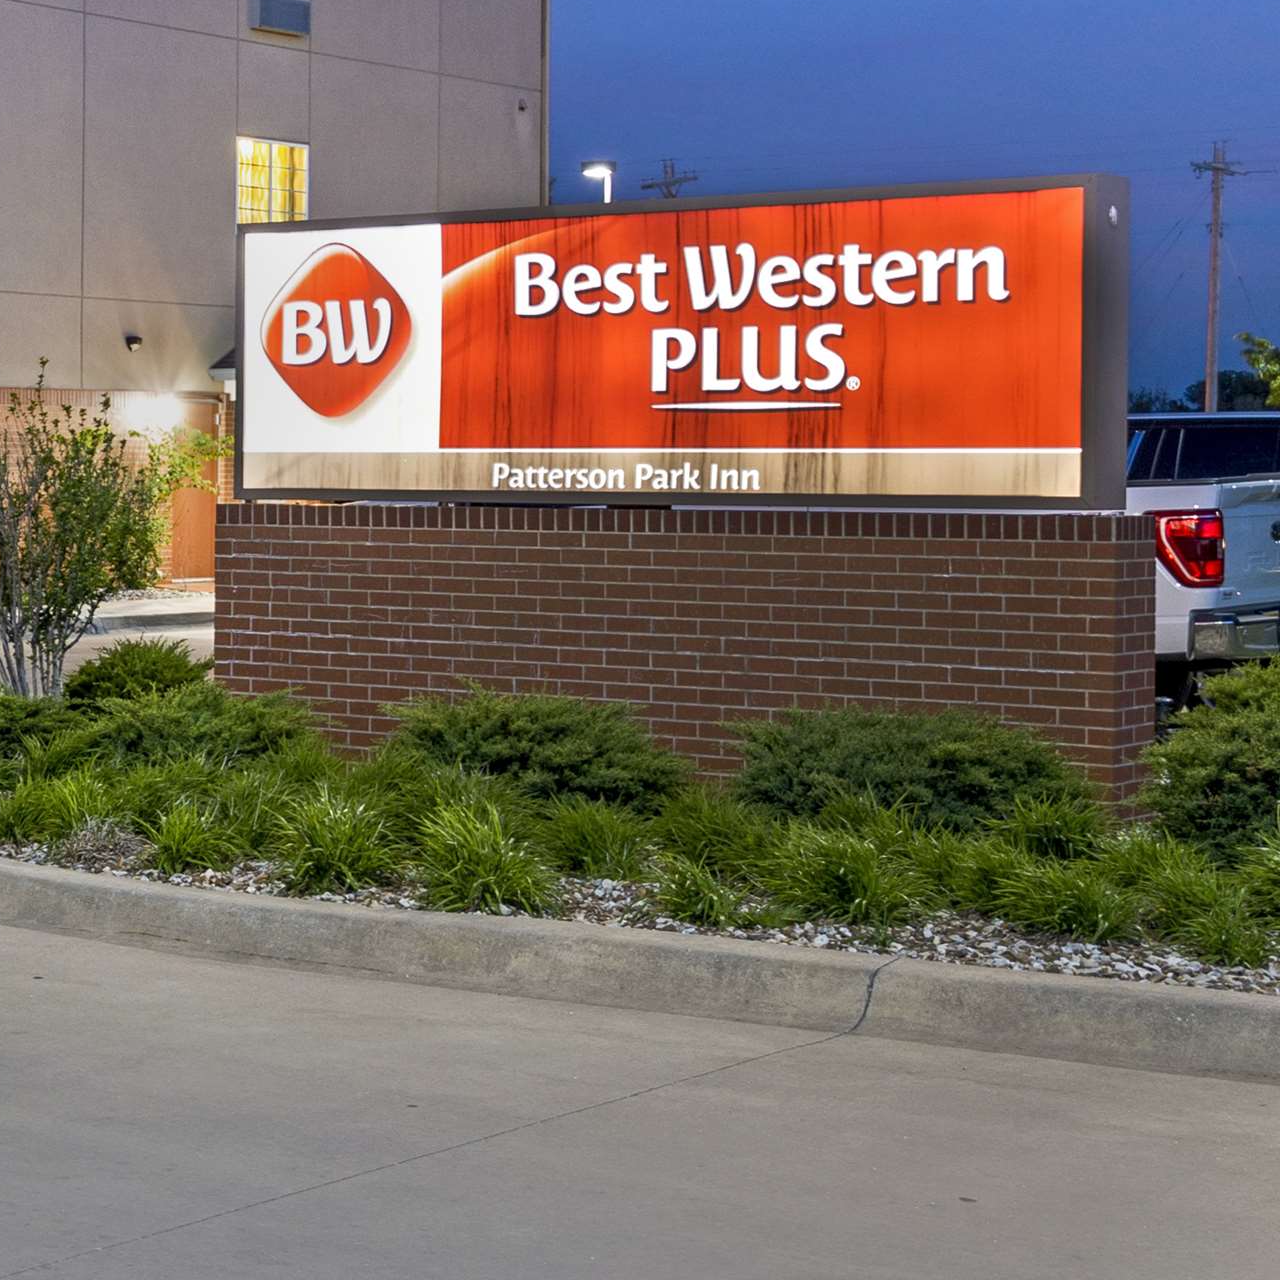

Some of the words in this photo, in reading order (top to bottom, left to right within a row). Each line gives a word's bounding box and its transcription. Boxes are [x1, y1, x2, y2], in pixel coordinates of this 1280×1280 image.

[514, 252, 669, 316] Best
[683, 242, 1010, 311] Western
[281, 297, 392, 365] BW
[492, 463, 625, 489] Patterson
[635, 462, 700, 490] Park
[709, 463, 760, 490] Inn
